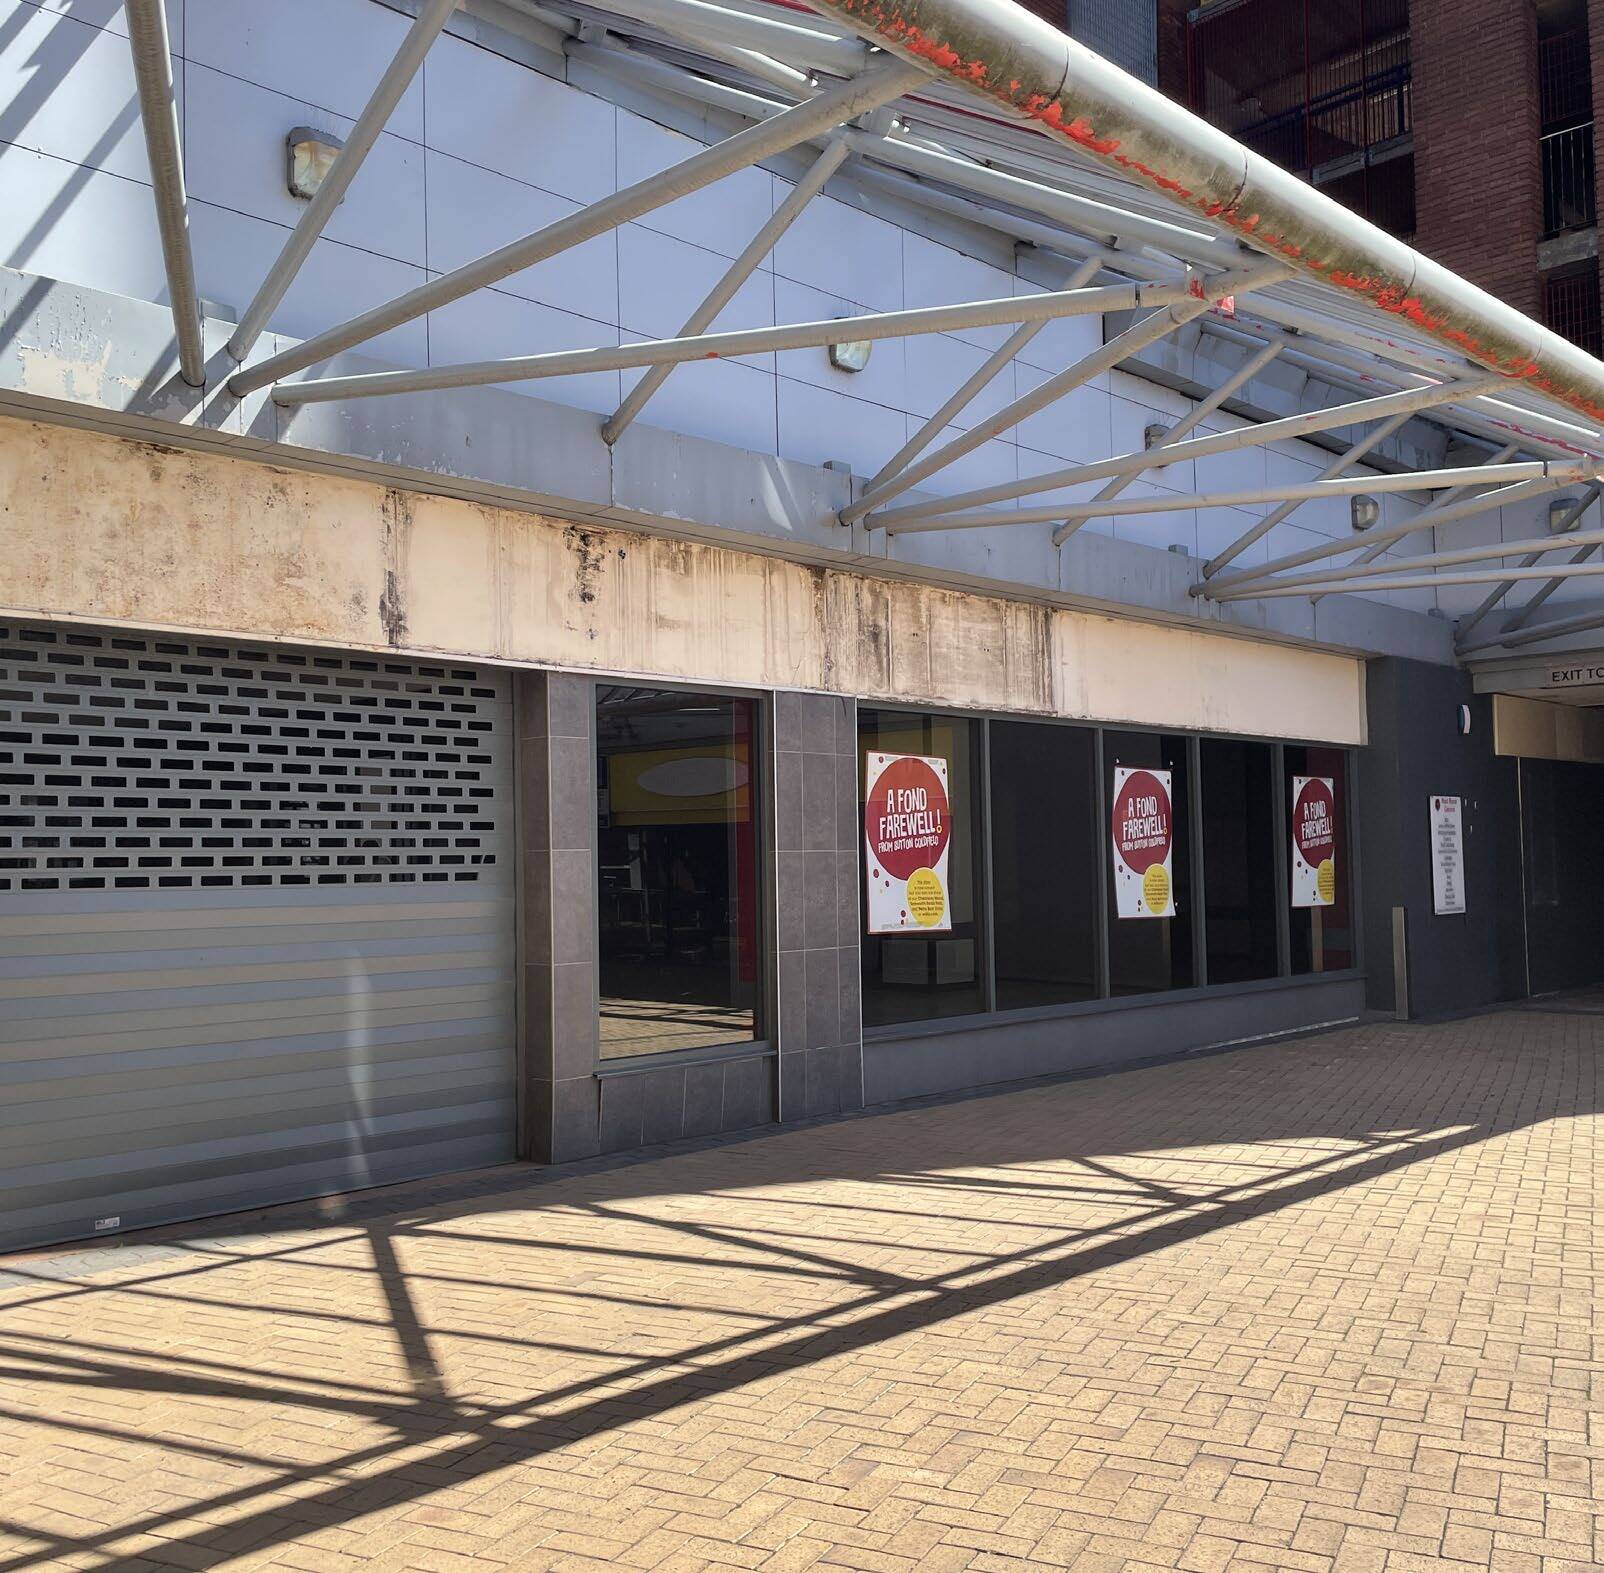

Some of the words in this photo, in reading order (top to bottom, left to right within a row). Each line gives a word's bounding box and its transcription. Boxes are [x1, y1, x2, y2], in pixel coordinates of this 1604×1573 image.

[1552, 669, 1583, 682] EXIT
[887, 789, 895, 813] A
[897, 787, 927, 813] FOND
[1128, 797, 1135, 818] A
[1136, 795, 1158, 817] FOND
[1303, 802, 1310, 820] A
[1310, 800, 1326, 820] FOND
[879, 809, 942, 840] FAREWELL!
[1122, 813, 1168, 841] FAREWELL!
[878, 841, 893, 853] FROM
